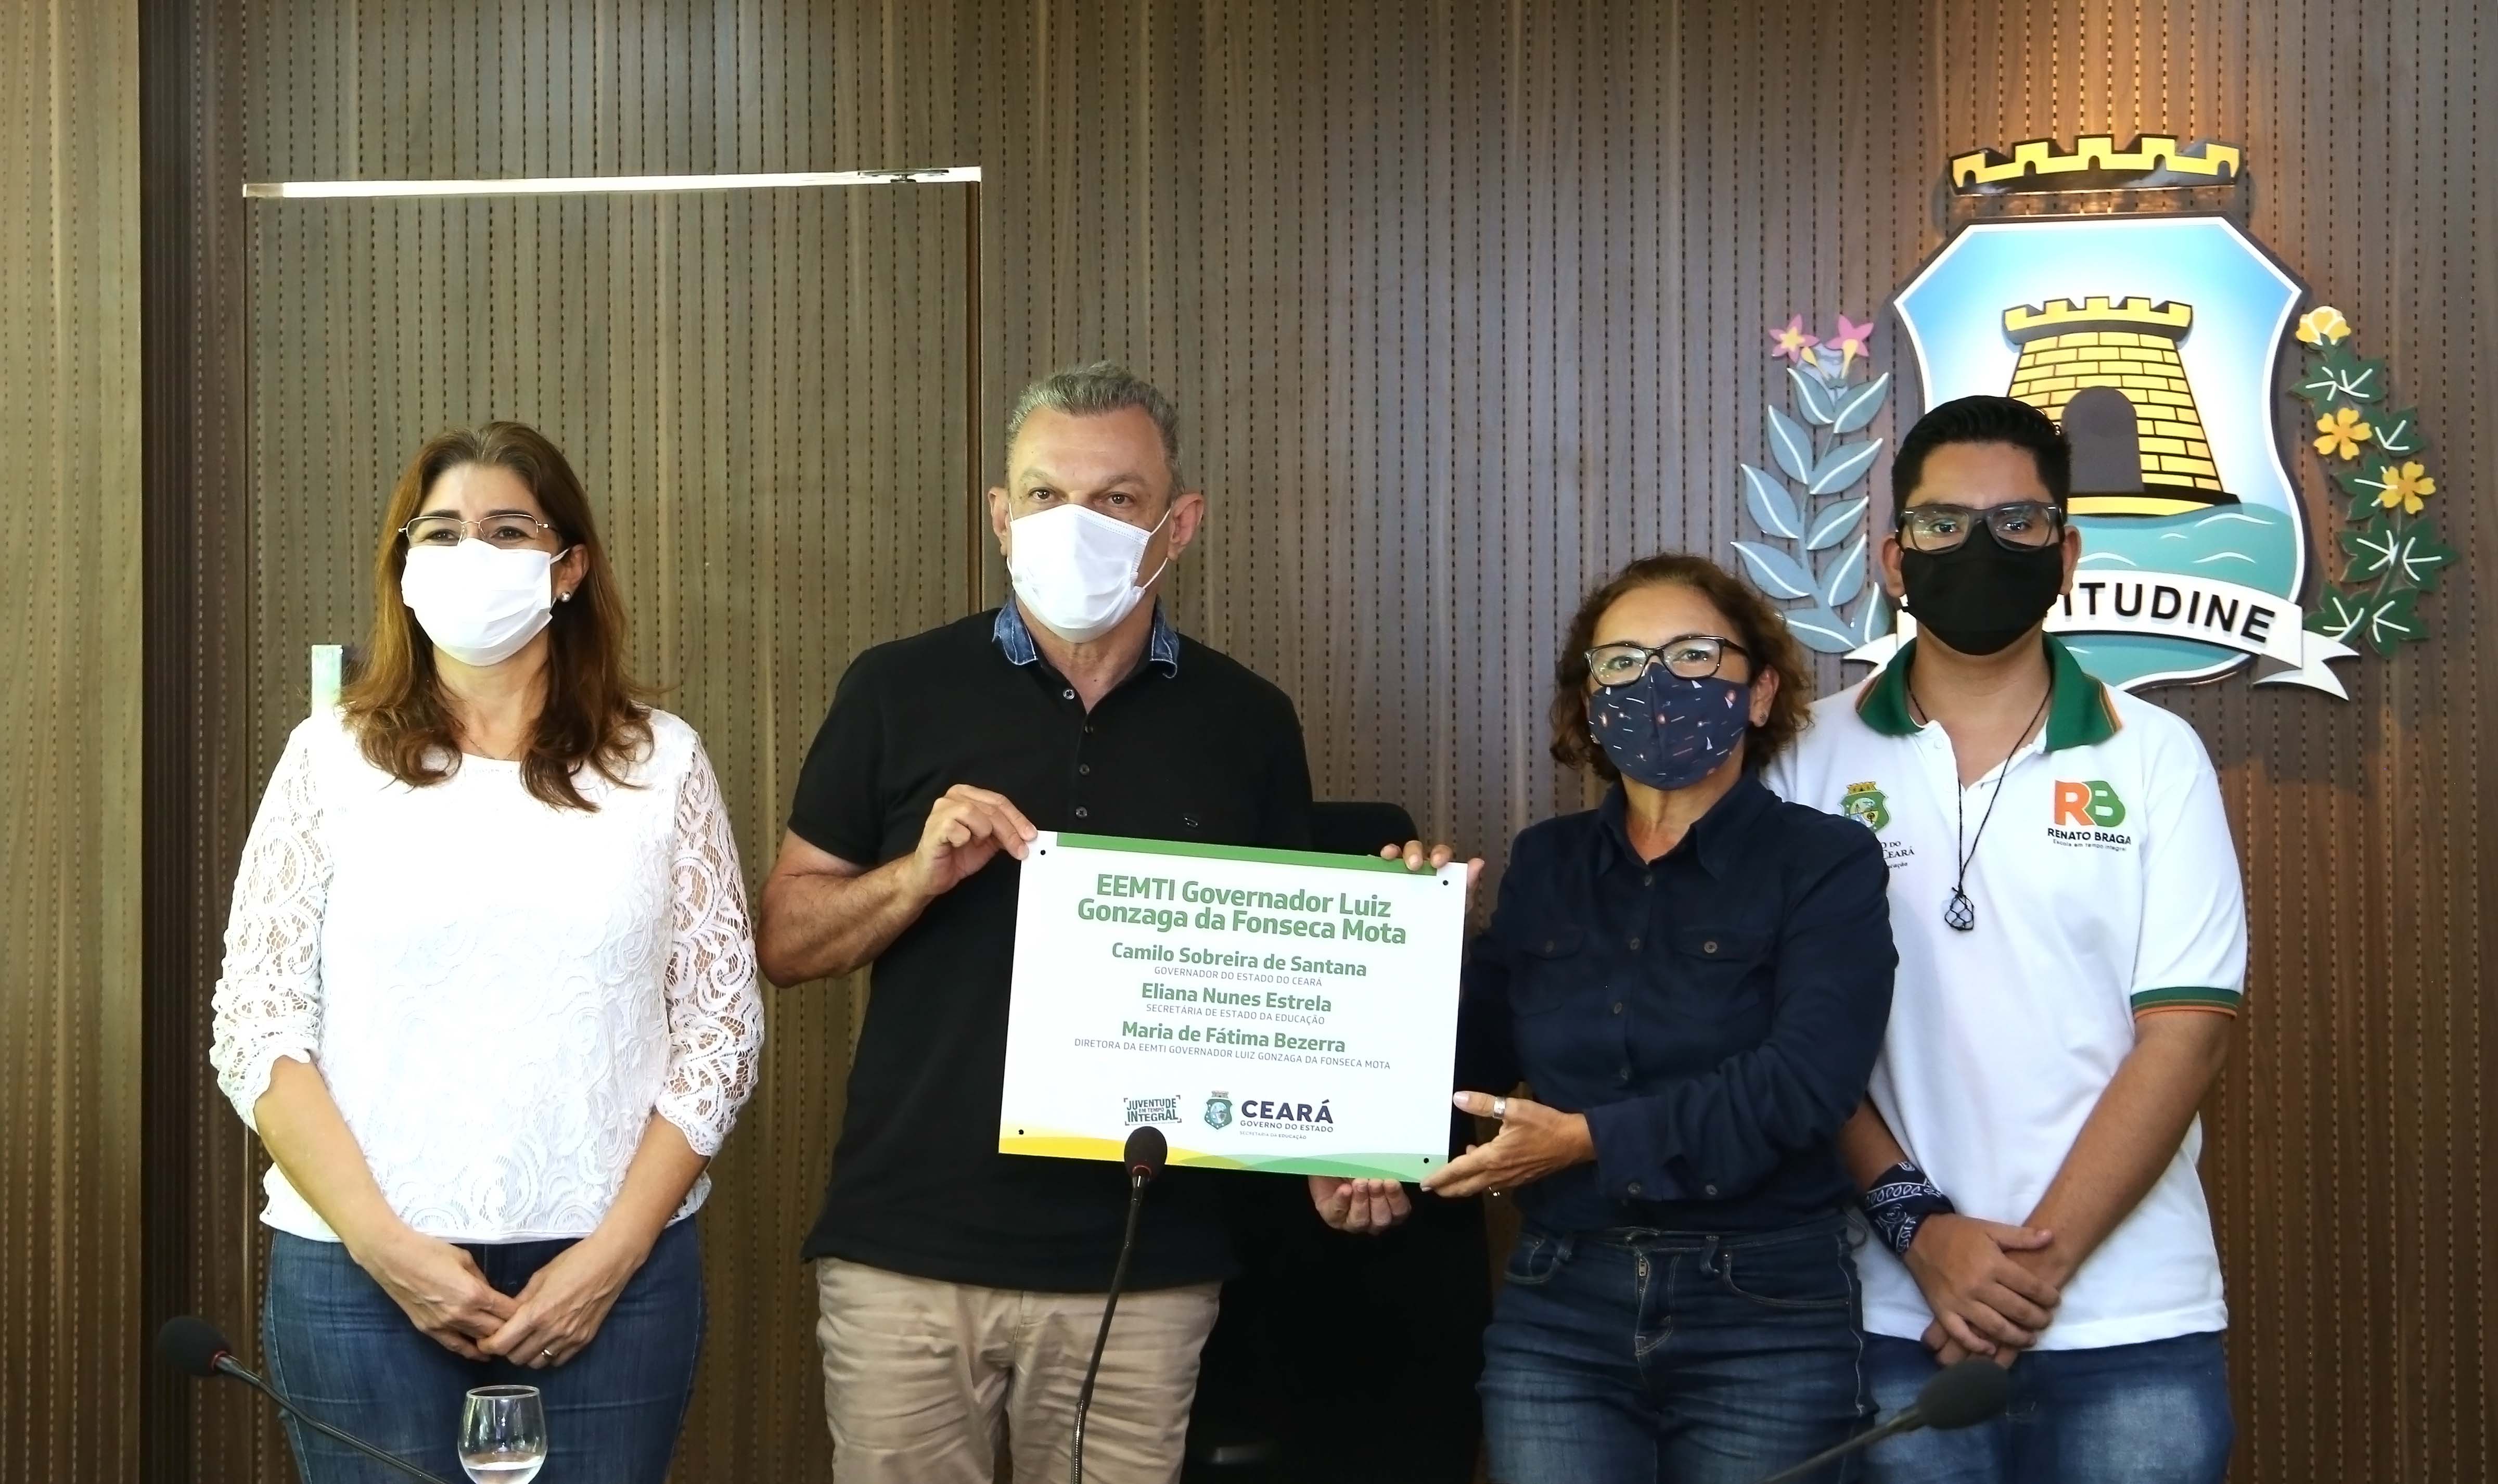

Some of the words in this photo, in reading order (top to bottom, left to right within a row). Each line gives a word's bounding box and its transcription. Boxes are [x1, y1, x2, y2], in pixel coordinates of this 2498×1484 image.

[2044, 582, 2276, 643] ITUDINE
[2054, 779, 2125, 827] RB
[2047, 828, 2091, 840] RENATO
[2095, 832, 2132, 845] BRAGA
[2053, 839, 2072, 847] Escola
[1097, 874, 1175, 901] EEMTI
[1182, 880, 1334, 913] Governador
[1339, 892, 1391, 918] Luiz
[1078, 898, 1188, 933] Gonzaga
[1195, 906, 1225, 930] da
[1232, 910, 1336, 939] Fonseca
[1342, 918, 1406, 944] Mota
[1112, 942, 1174, 962] Camilo
[1179, 947, 1258, 968] Sobreira
[1263, 953, 1286, 970] de
[1290, 956, 1366, 977] Santana
[1155, 966, 1219, 978] GOVERNADOR
[1237, 973, 1274, 983] ESTADO
[1276, 976, 1289, 984] DO
[1292, 976, 1322, 986] CEARÁ
[1142, 982, 1198, 1002] Eliana
[1202, 987, 1261, 1007] Nunes
[1266, 992, 1331, 1012] Estrela
[1147, 1004, 1202, 1015] SECRETÁRIA
[1205, 1008, 1217, 1016] DE
[1220, 1009, 1257, 1019] ESTADO
[1260, 1012, 1272, 1020] DA
[1275, 1014, 1325, 1025] EDUCAÇÃO
[1122, 1021, 1173, 1040] Maria
[1178, 1025, 1201, 1042] de
[1206, 1027, 1269, 1047] Fátima
[1274, 1032, 1345, 1053] Bezerra
[1074, 1039, 1120, 1049] DIRETORA
[1139, 1043, 1166, 1053] EEMTI
[1169, 1045, 1233, 1058] GOVERNADOR
[1235, 1051, 1255, 1059] LUIZ
[1258, 1052, 1302, 1063] GONZAGA
[1321, 1057, 1362, 1067] FONSECA
[1365, 1060, 1390, 1069] MOTA
[1126, 1098, 1176, 1110] JUVENTUDE
[1127, 1109, 1178, 1122] INTEGRAL
[1241, 1098, 1334, 1124] CEARÁ
[1240, 1120, 1283, 1130] GOVERNO
[1300, 1124, 1334, 1133] ESTADO
